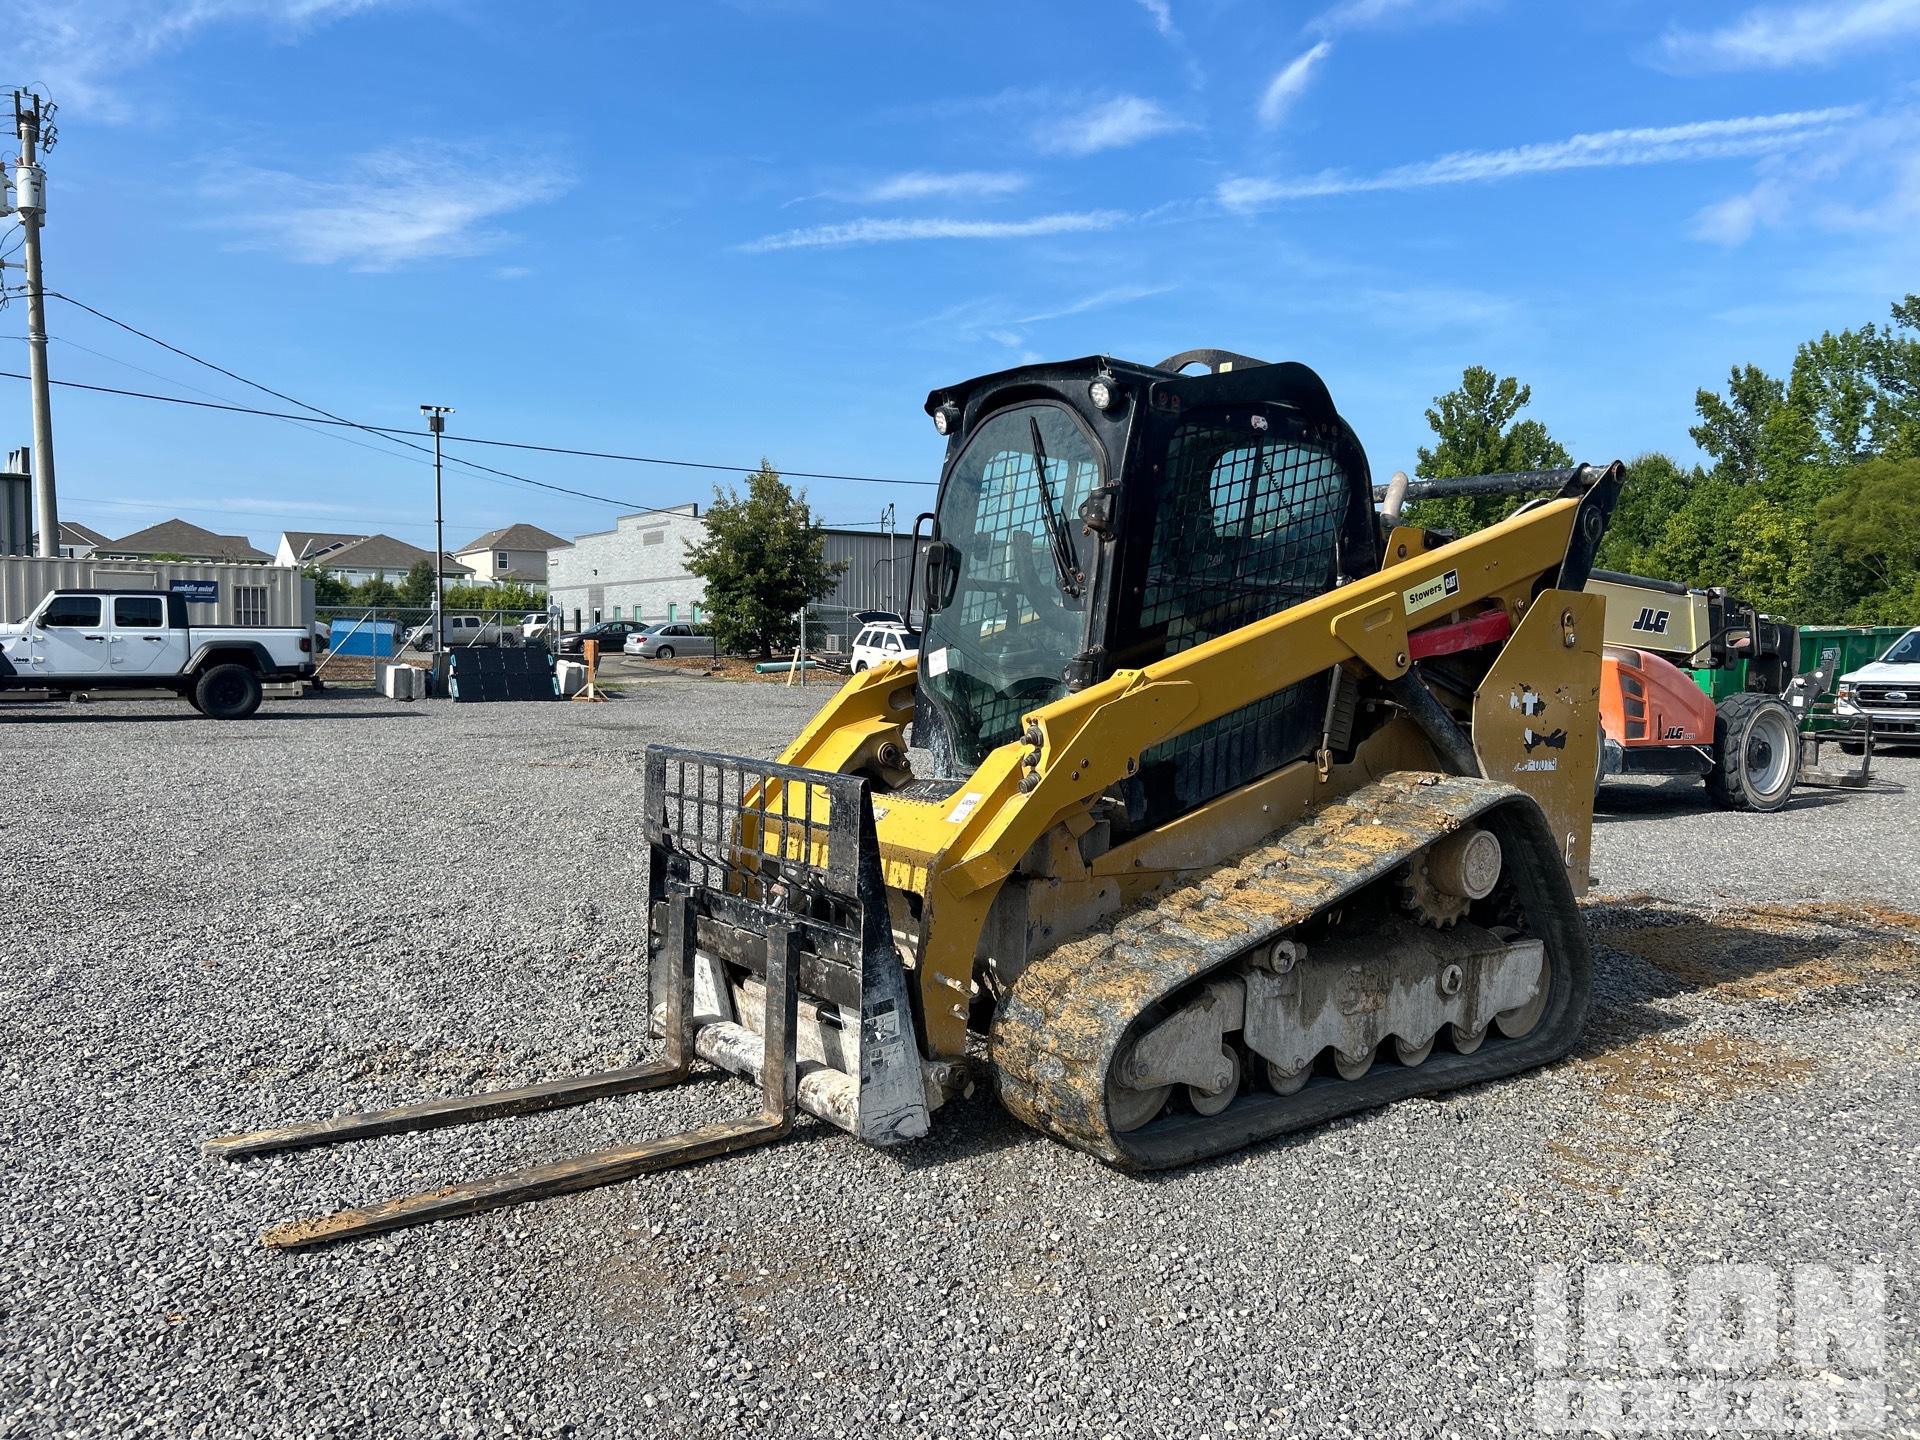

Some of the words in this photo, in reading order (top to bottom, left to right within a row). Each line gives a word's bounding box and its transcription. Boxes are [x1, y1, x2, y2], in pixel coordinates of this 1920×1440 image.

[173, 584, 197, 592] mobile
[198, 585, 215, 593] mini
[1409, 583, 1443, 604] Stowers
[1445, 575, 1456, 590] CAT
[1631, 606, 1671, 635] JLG
[1664, 726, 1684, 740] JLG
